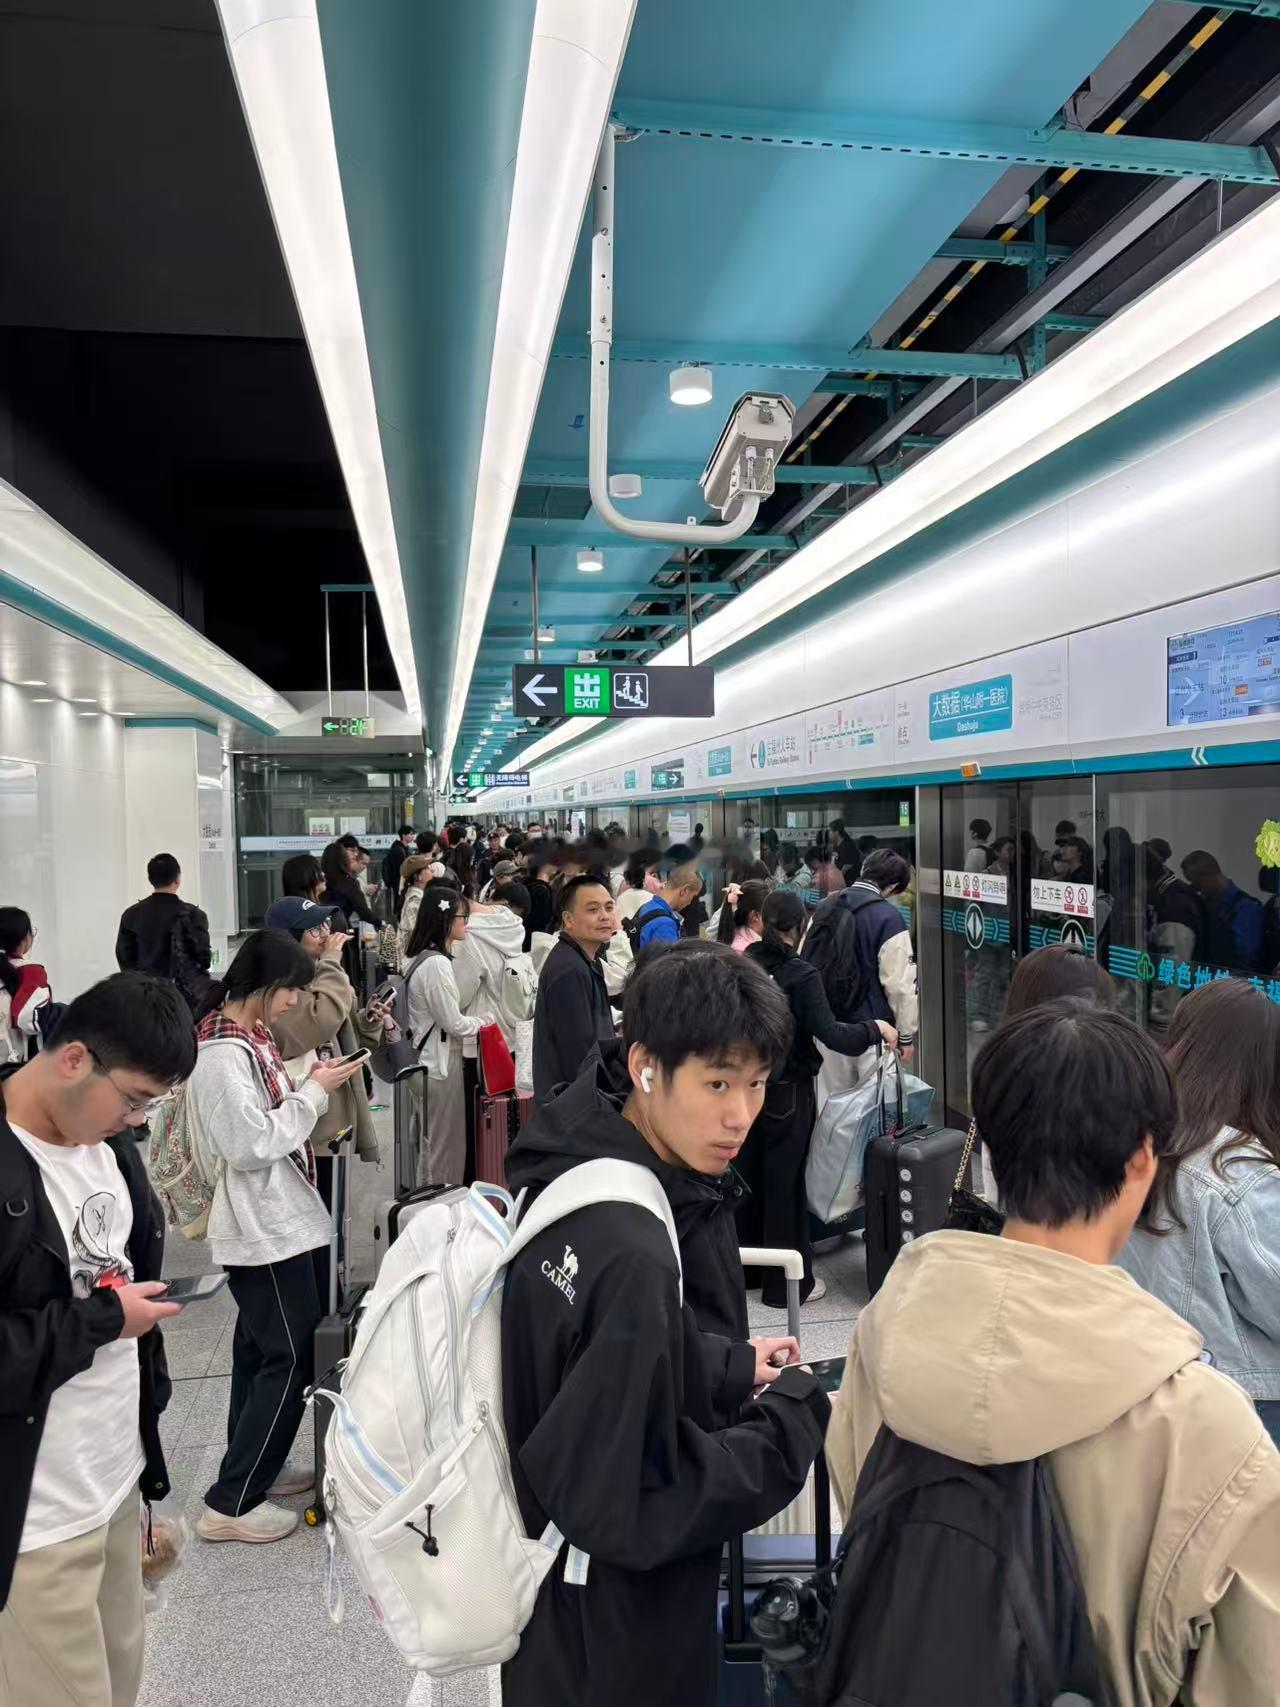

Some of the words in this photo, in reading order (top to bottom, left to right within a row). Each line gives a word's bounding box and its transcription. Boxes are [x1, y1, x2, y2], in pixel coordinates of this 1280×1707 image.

[574, 673, 600, 697] 出
[574, 698, 600, 709] EXIT
[1032, 884, 1062, 901] 勿上下车
[541, 1260, 576, 1305] CAMEL
